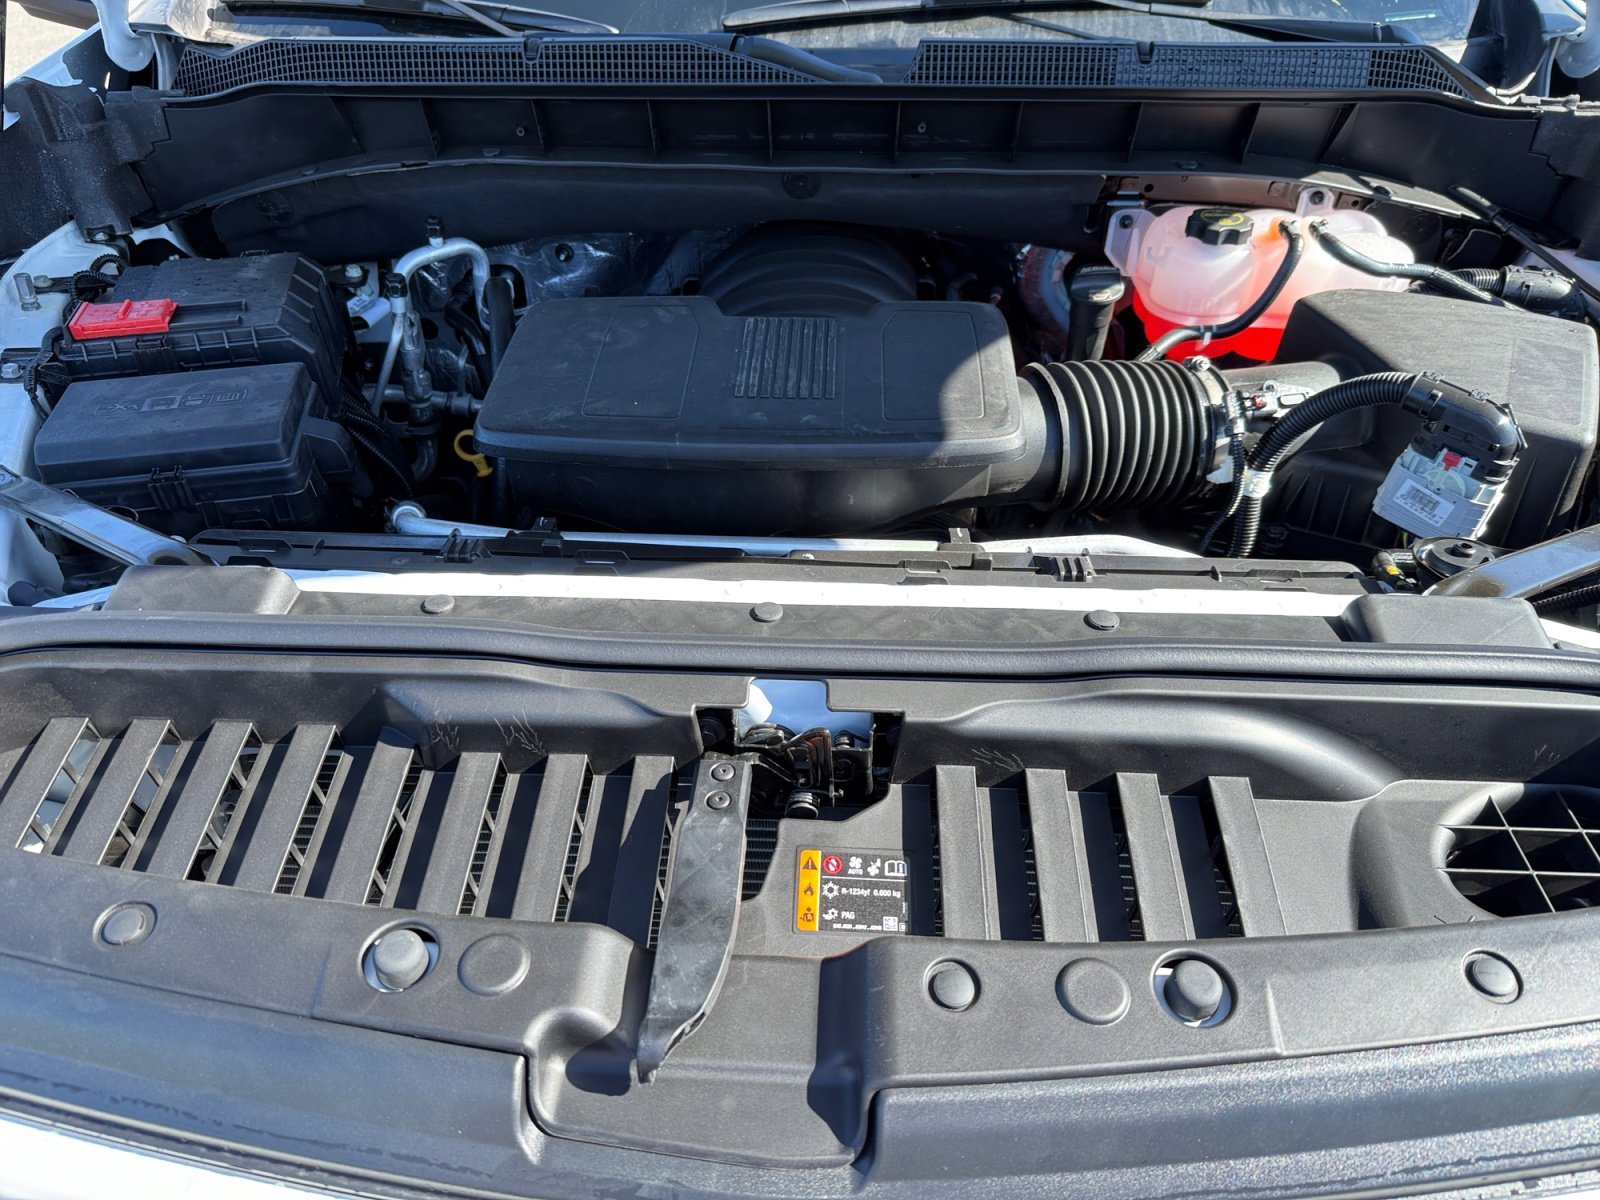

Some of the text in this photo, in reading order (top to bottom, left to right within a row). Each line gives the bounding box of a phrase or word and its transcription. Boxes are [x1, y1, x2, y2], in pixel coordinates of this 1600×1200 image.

[841, 888, 870, 897] R-1234yf
[892, 890, 901, 899] kg
[841, 911, 855, 919] PAG
